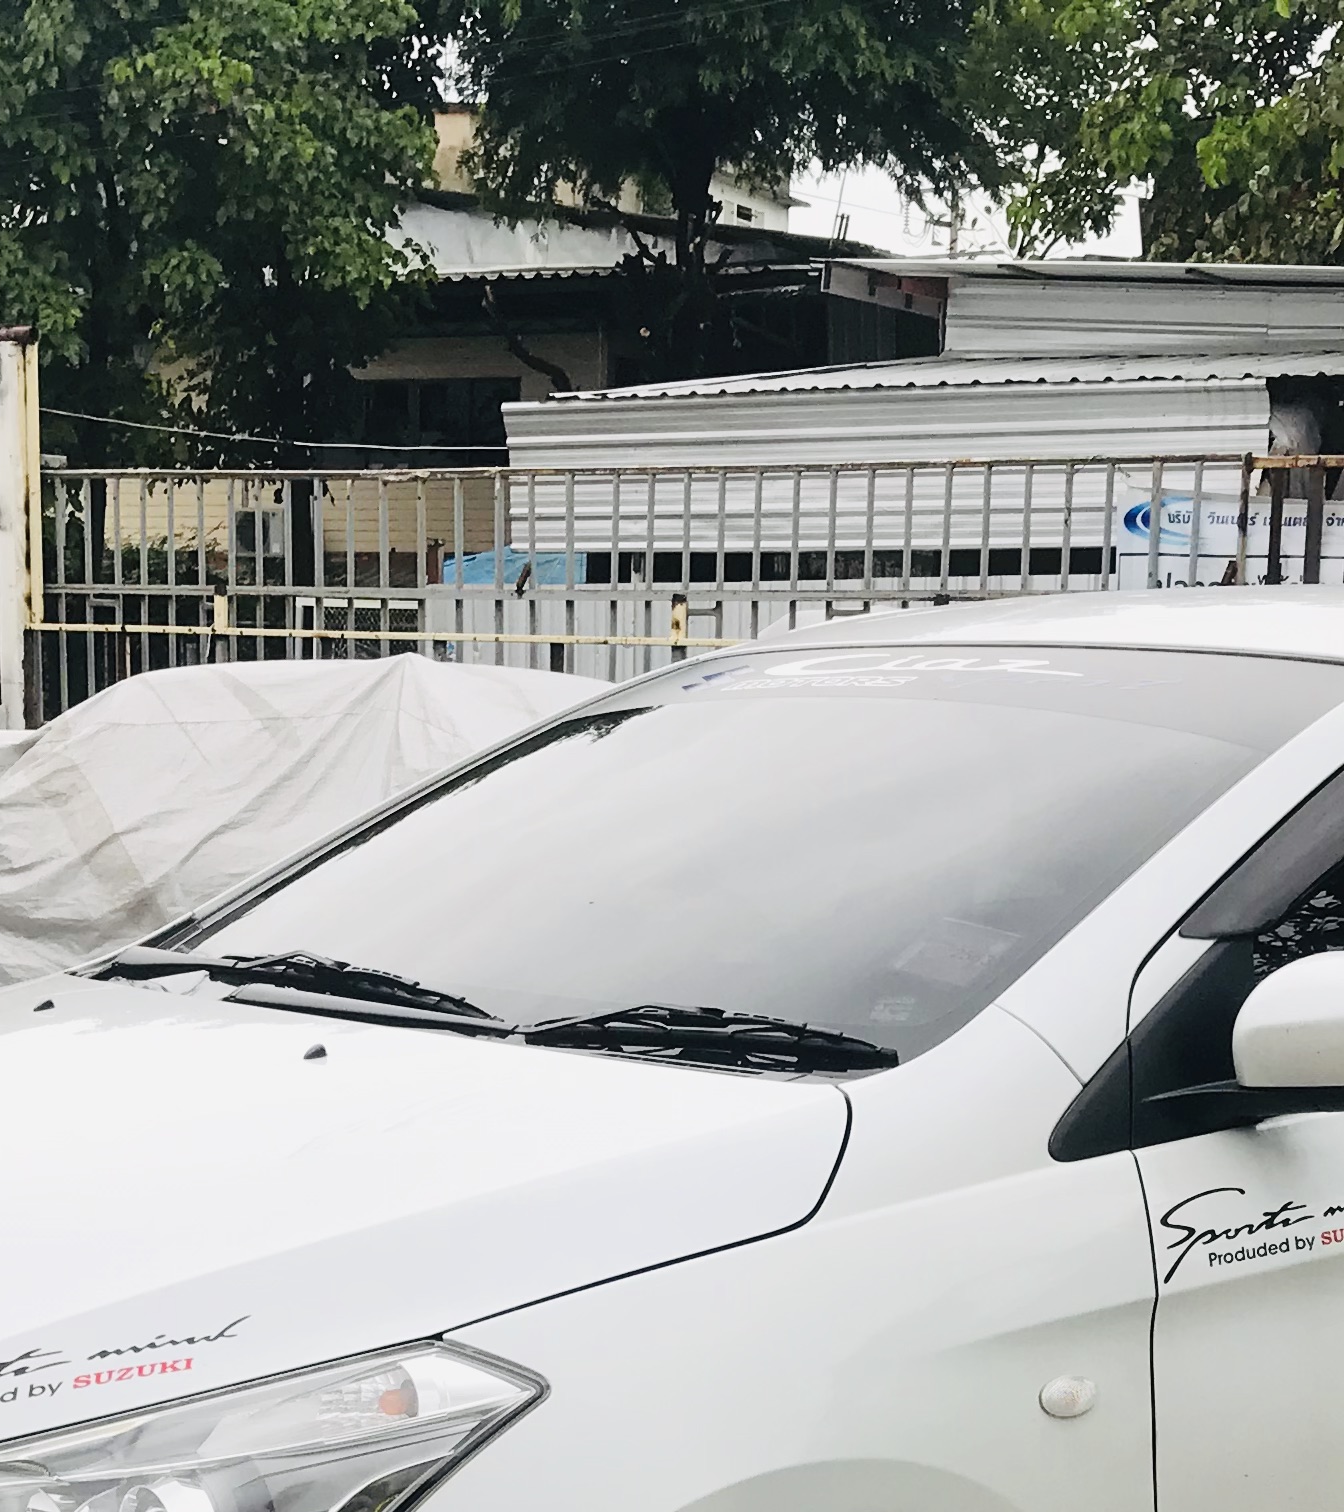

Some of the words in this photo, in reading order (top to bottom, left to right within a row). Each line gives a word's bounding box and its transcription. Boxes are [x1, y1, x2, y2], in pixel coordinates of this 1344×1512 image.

[1207, 1236, 1291, 1268] Produded
[1294, 1235, 1316, 1252] by
[28, 1380, 64, 1398] by
[71, 1357, 195, 1390] SUZUKI
